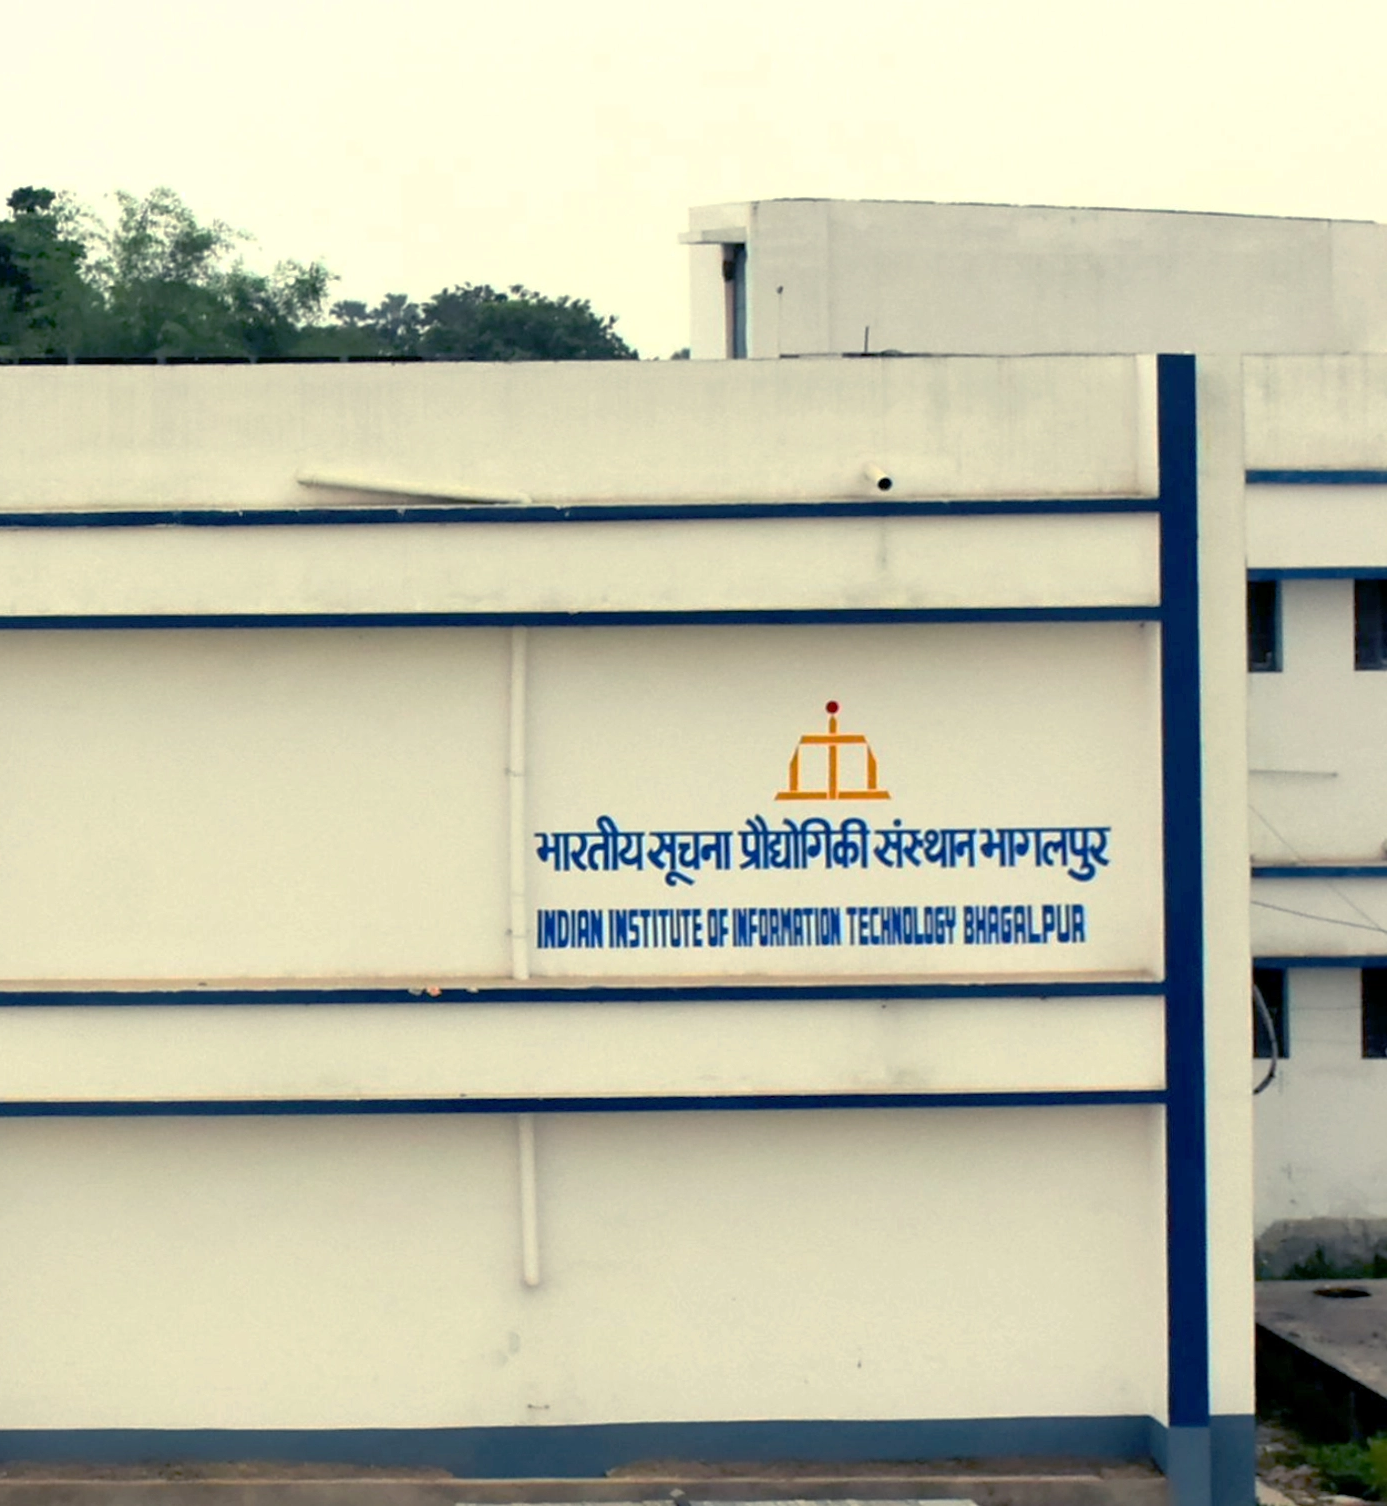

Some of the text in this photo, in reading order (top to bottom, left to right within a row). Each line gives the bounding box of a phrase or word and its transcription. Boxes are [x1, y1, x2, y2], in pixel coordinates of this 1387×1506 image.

[534, 814, 1111, 887] भारतीय सूचना प्रौद्योगिकी संस्थान भागलपुर
[537, 904, 1086, 949] INDIAN INSTITUTE OF INFORMATION TECHNOLOGY BHAGALPUR
